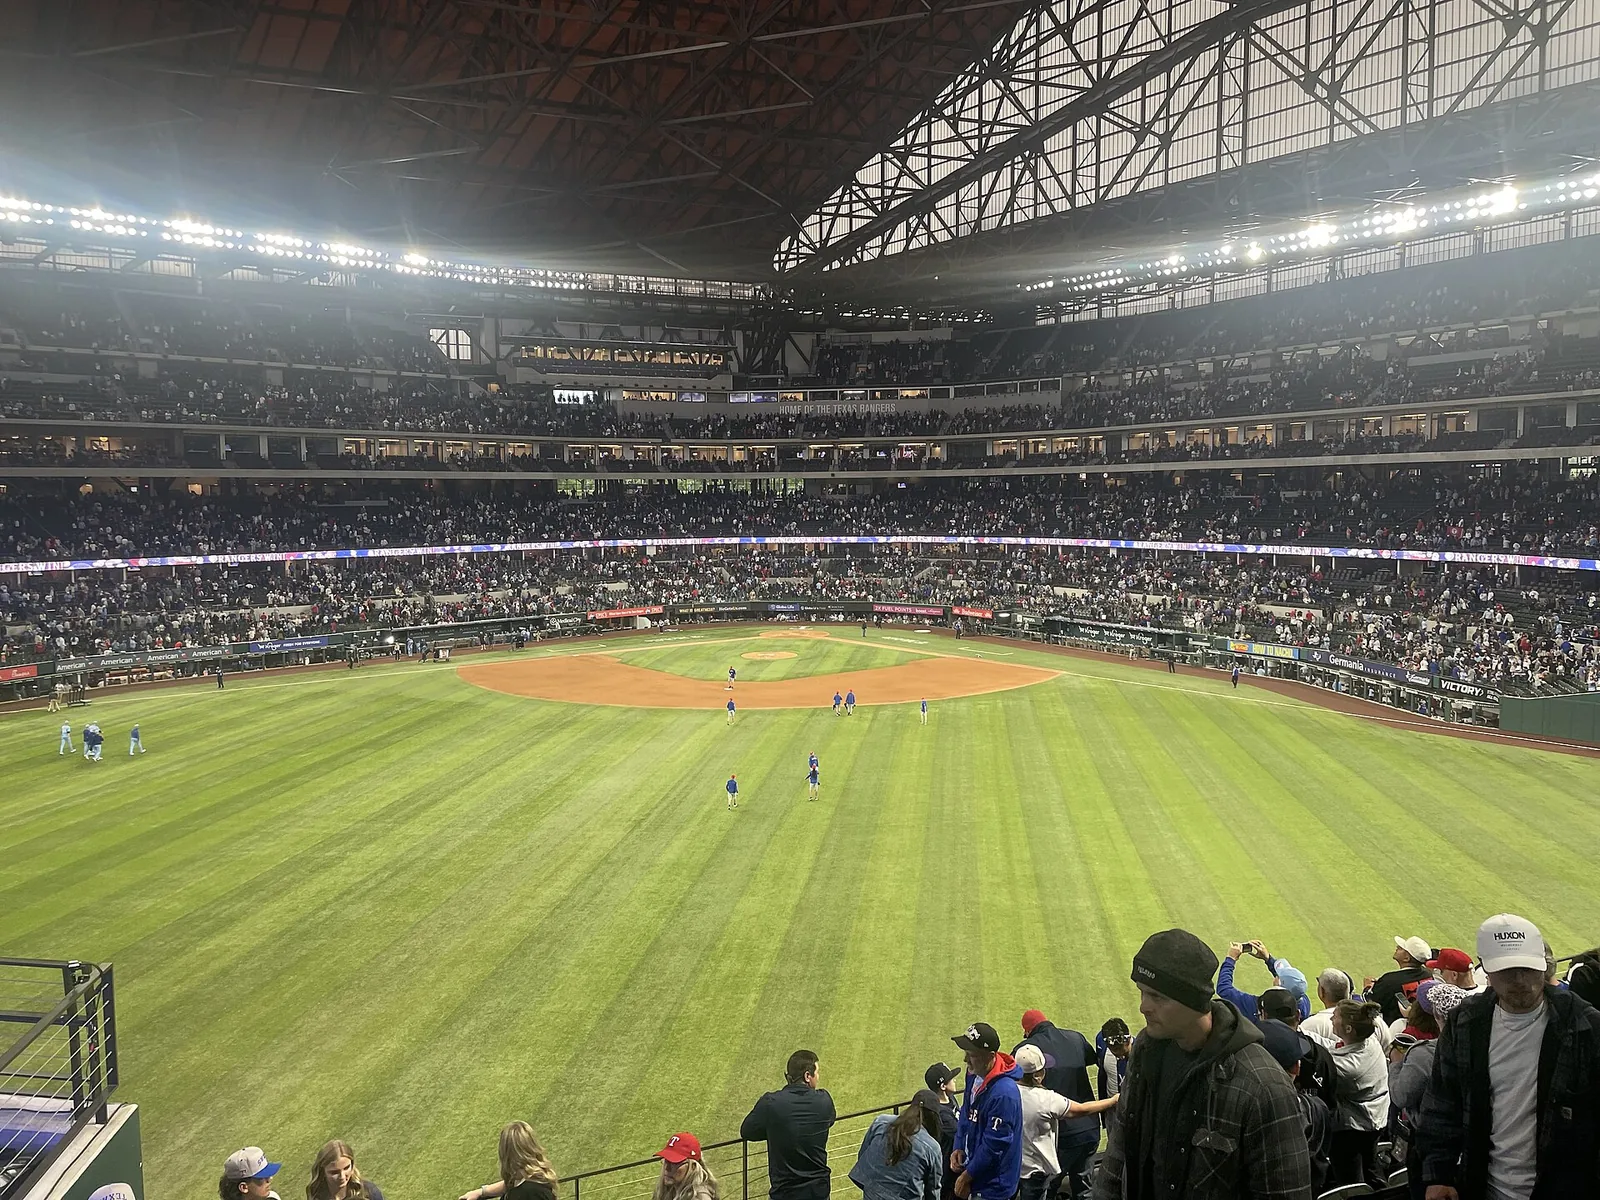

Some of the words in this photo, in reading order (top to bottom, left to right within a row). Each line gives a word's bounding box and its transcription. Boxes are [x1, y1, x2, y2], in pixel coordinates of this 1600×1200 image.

[780, 406, 801, 414] HOME
[804, 405, 814, 414] OF
[816, 404, 830, 414] THE
[833, 404, 857, 413] TEXAS
[860, 403, 896, 413] RANGERS
[218, 554, 261, 563] RANGERS
[263, 552, 286, 562] WIN!
[1454, 553, 1504, 564] RANGERS
[1507, 555, 1528, 566] WIN!
[1085, 626, 1100, 637] Kroger
[1110, 629, 1125, 641] Kroger
[1136, 632, 1152, 644] Kroger
[192, 649, 222, 657] American
[1253, 644, 1264, 654] HOW
[1267, 645, 1273, 655] TO
[1275, 646, 1293, 658] NACHO
[100, 657, 133, 666] American
[147, 653, 178, 661] American
[57, 662, 85, 671] American
[1329, 654, 1364, 671] Germania
[1364, 667, 1396, 678] INSURANCE
[1441, 680, 1481, 696] VICTORY
[1494, 932, 1525, 940] HUXON
[992, 1116, 1002, 1131] T
[669, 1136, 680, 1146] T
